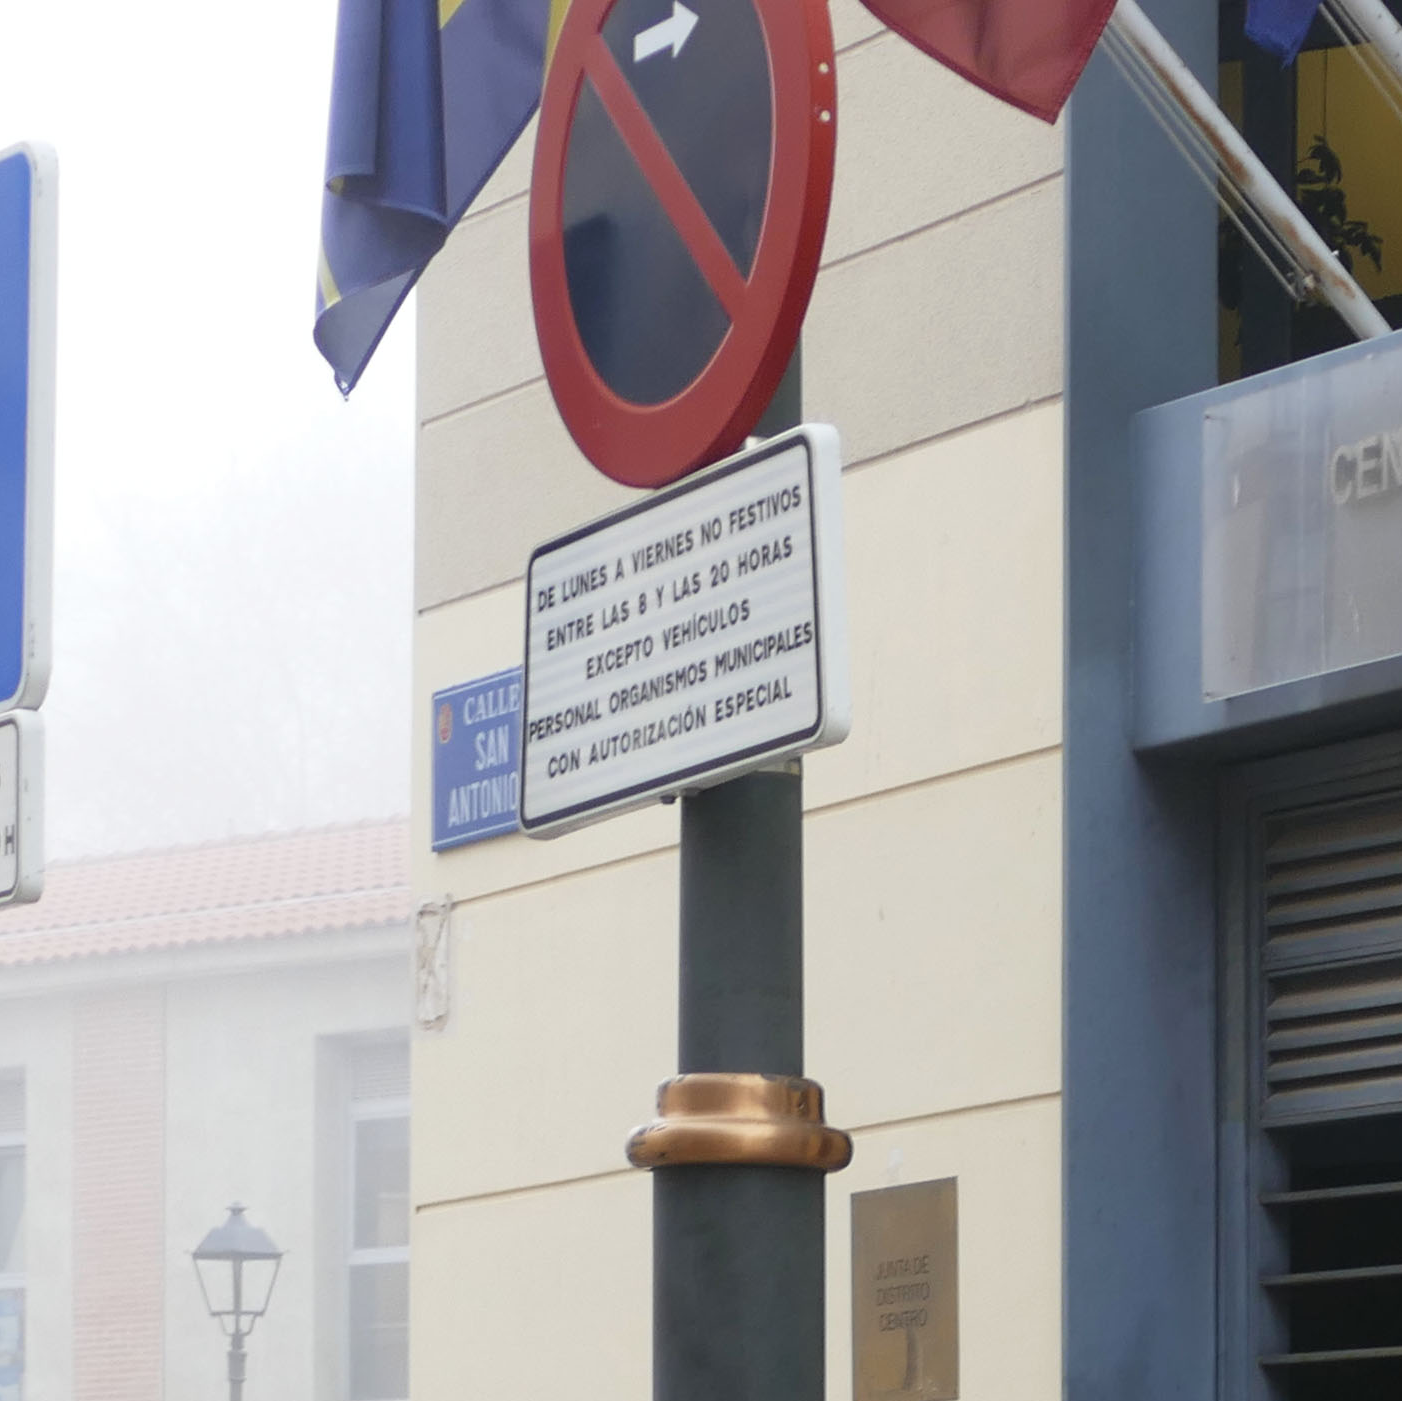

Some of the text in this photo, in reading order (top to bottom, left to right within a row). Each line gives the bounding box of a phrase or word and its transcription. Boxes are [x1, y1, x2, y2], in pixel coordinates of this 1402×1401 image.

[538, 484, 801, 613] DE LUNES A VIERNES NO FESTIVOS
[547, 536, 793, 652] ENTRE LAS 8 Y LAS 20 HORAS
[586, 599, 750, 680] EXCEPTO VEHÍCULOS
[463, 683, 520, 727] CALLE
[529, 621, 813, 744] PERSONAL ORGANISMOS MUNICIPALES
[474, 724, 510, 771] SAN
[547, 676, 792, 779] CON AUTORIZACIÓN ESPECIAL
[4, 824, 15, 856] H
[448, 771, 519, 828] ANTONIO
